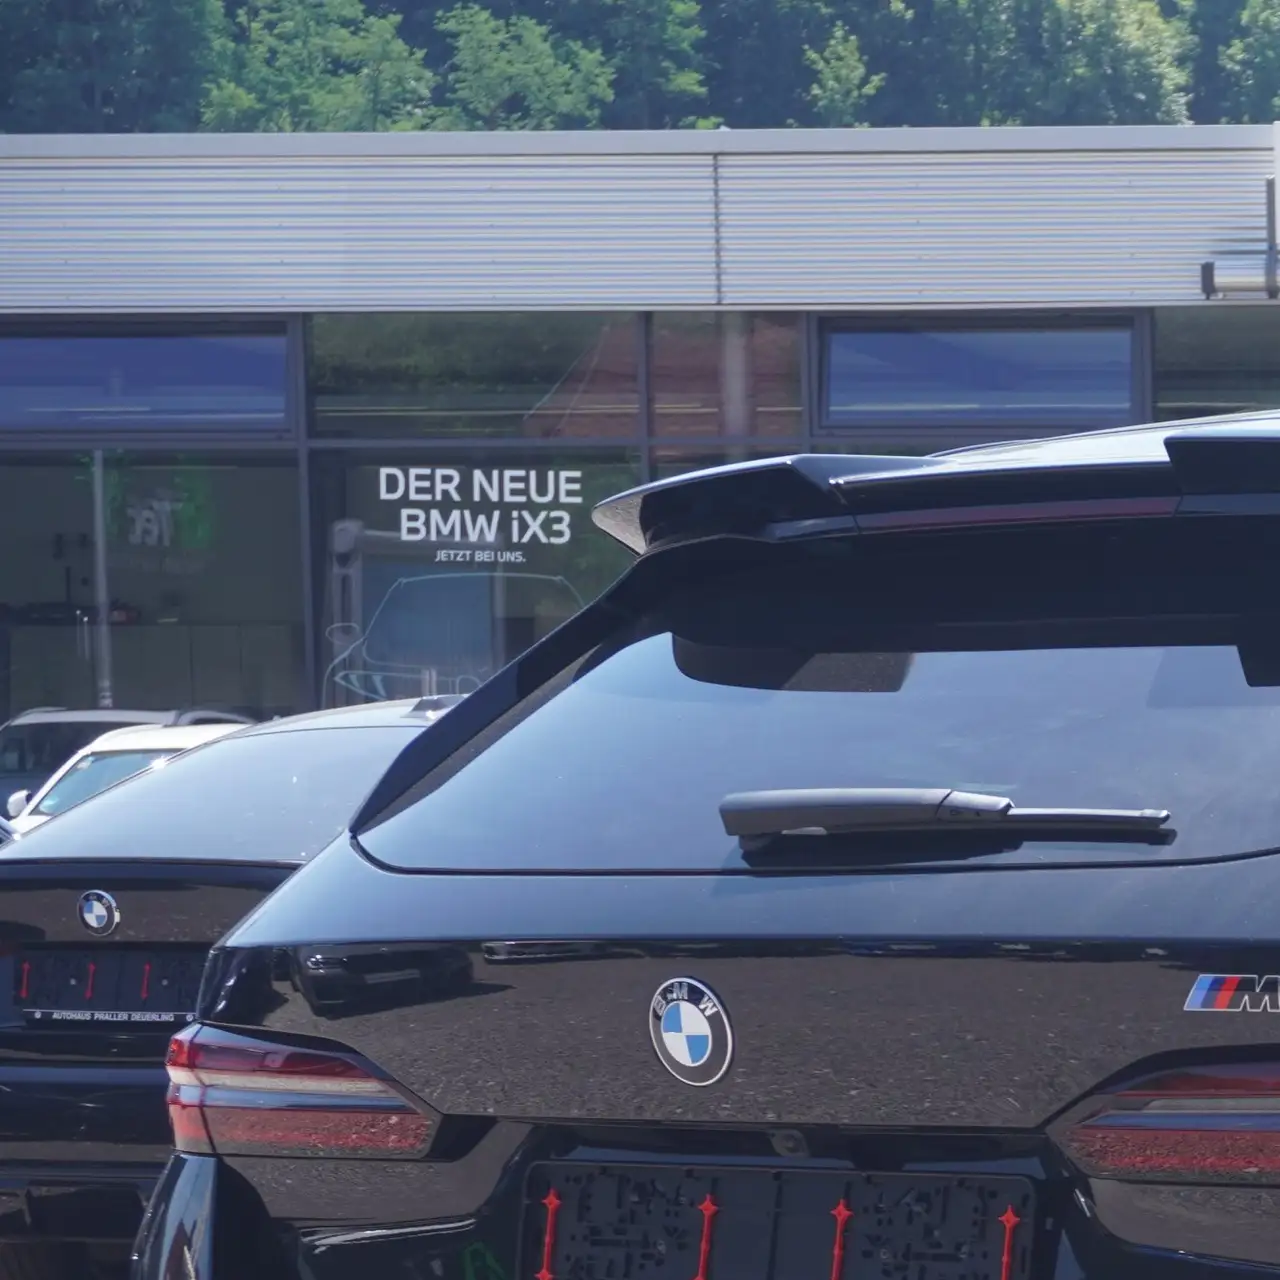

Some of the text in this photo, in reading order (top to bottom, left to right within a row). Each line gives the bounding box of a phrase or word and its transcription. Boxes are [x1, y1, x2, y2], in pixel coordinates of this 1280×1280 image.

[379, 467, 583, 503] DER NEUE
[401, 508, 571, 544] BMW iX3
[434, 550, 527, 562] JETZT BEI UNS.
[52, 1011, 174, 1022] AUTOHAUS PRALLER DEUERLING
[653, 982, 719, 1017] BMW
